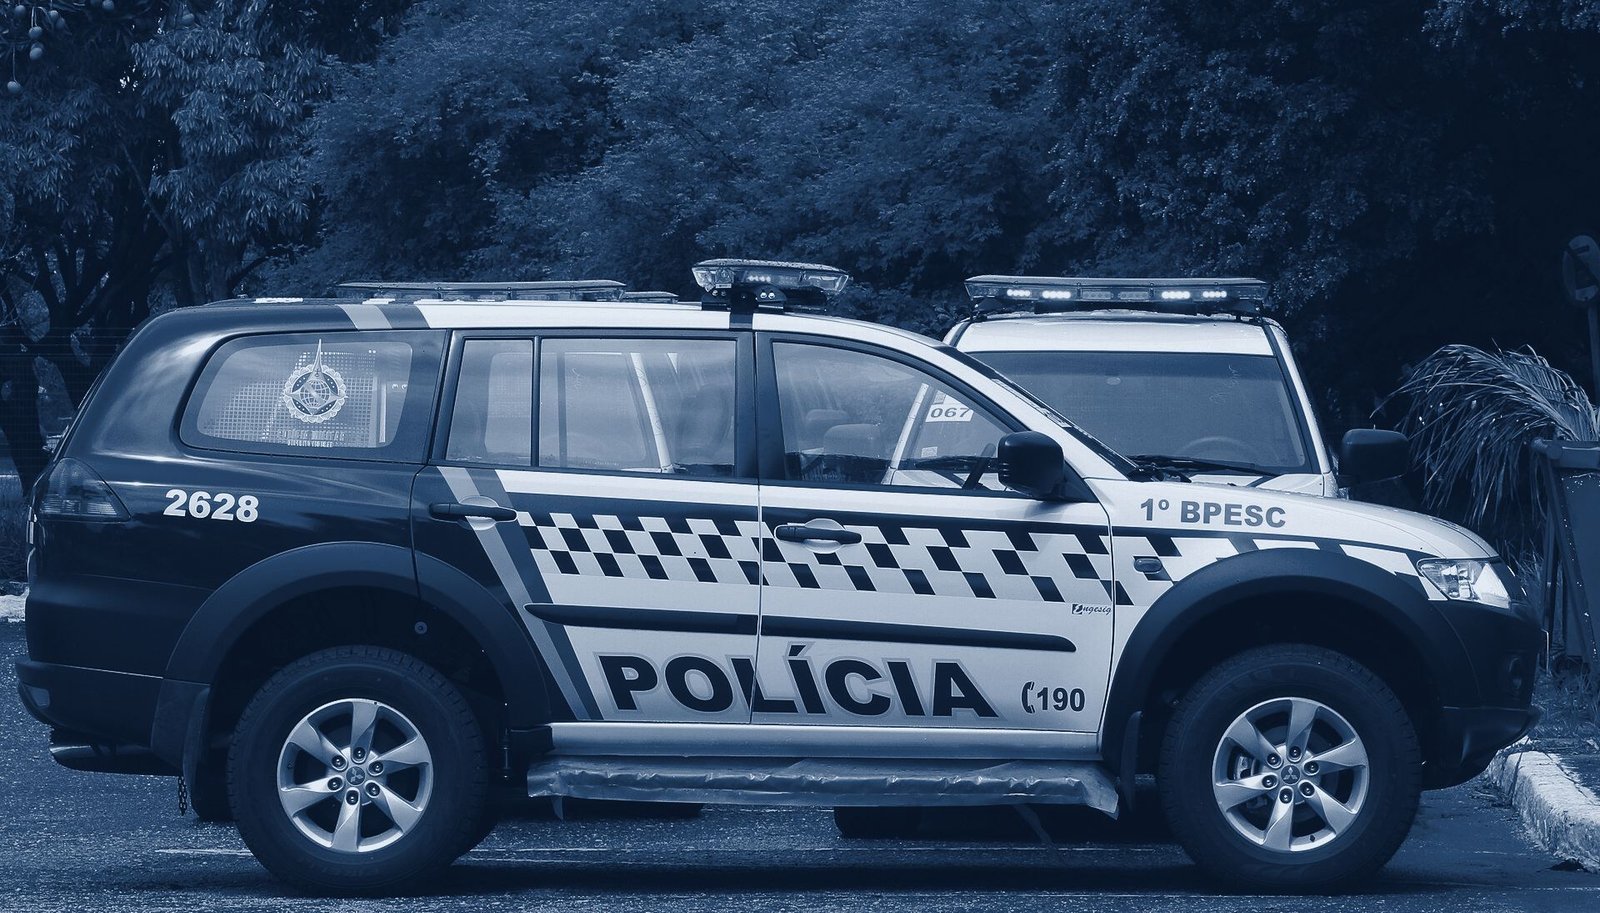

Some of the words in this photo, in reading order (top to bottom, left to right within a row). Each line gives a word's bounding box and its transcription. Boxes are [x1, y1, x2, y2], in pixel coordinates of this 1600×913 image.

[930, 407, 970, 419] 067
[163, 488, 259, 523] 2628
[1140, 498, 1170, 522] 1º
[1180, 500, 1286, 528] BPESC
[597, 644, 1001, 718] POLÍCIA
[1036, 686, 1086, 712] 190
